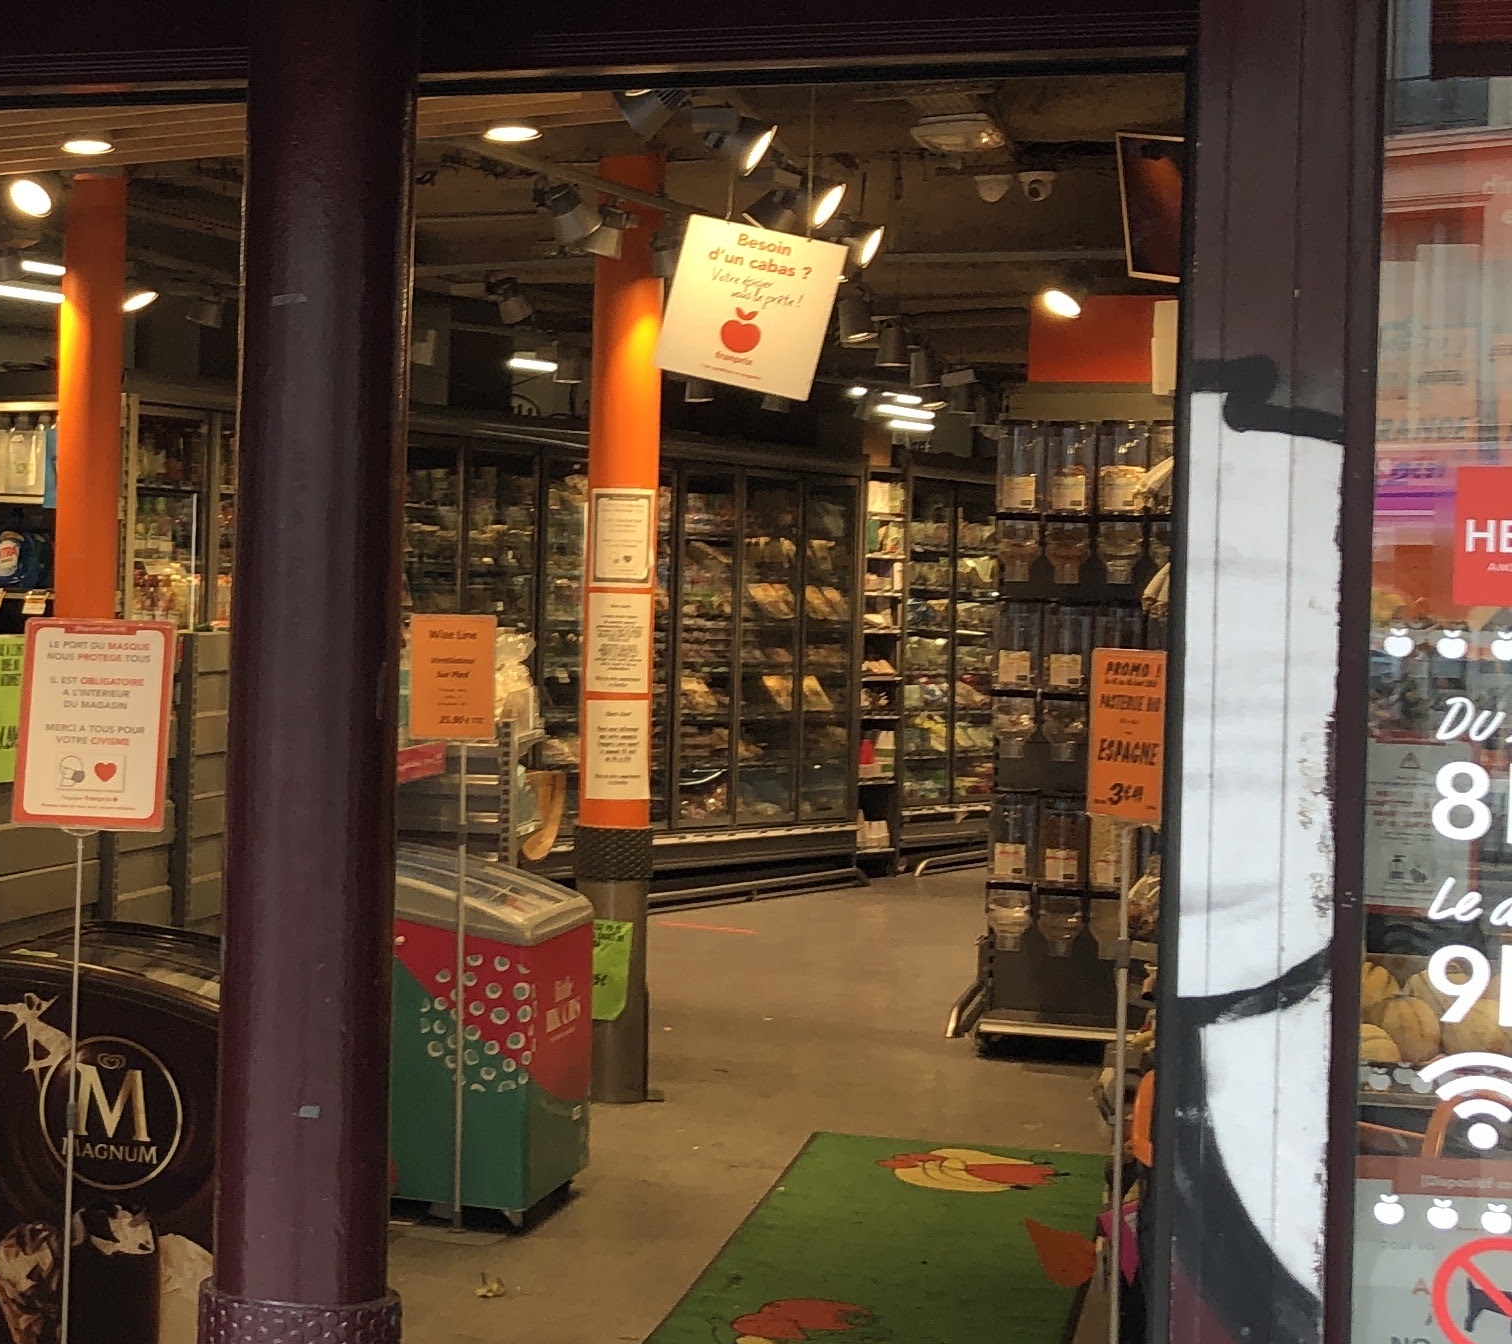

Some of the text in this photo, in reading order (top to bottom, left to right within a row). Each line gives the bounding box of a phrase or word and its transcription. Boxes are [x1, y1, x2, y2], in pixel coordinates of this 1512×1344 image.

[737, 233, 792, 256] Besoin
[749, 259, 796, 277] cabas
[49, 640, 151, 651] LE PORT DU MASQUE
[46, 652, 75, 661] NOUS
[125, 654, 151, 663] TOUS
[61, 676, 78, 685] EST
[80, 676, 145, 687] OBLIGATOIRE
[63, 700, 128, 710] DU MAGASIN
[1435, 696, 1507, 742] Du
[45, 723, 77, 732] MERCI
[89, 724, 115, 734] TOUS
[117, 725, 146, 735] POUR
[56, 736, 131, 746] VOTRE CIVISME
[1427, 877, 1484, 922] Le
[71, 1061, 151, 1144] M
[62, 1137, 159, 1165] MAGNUM
